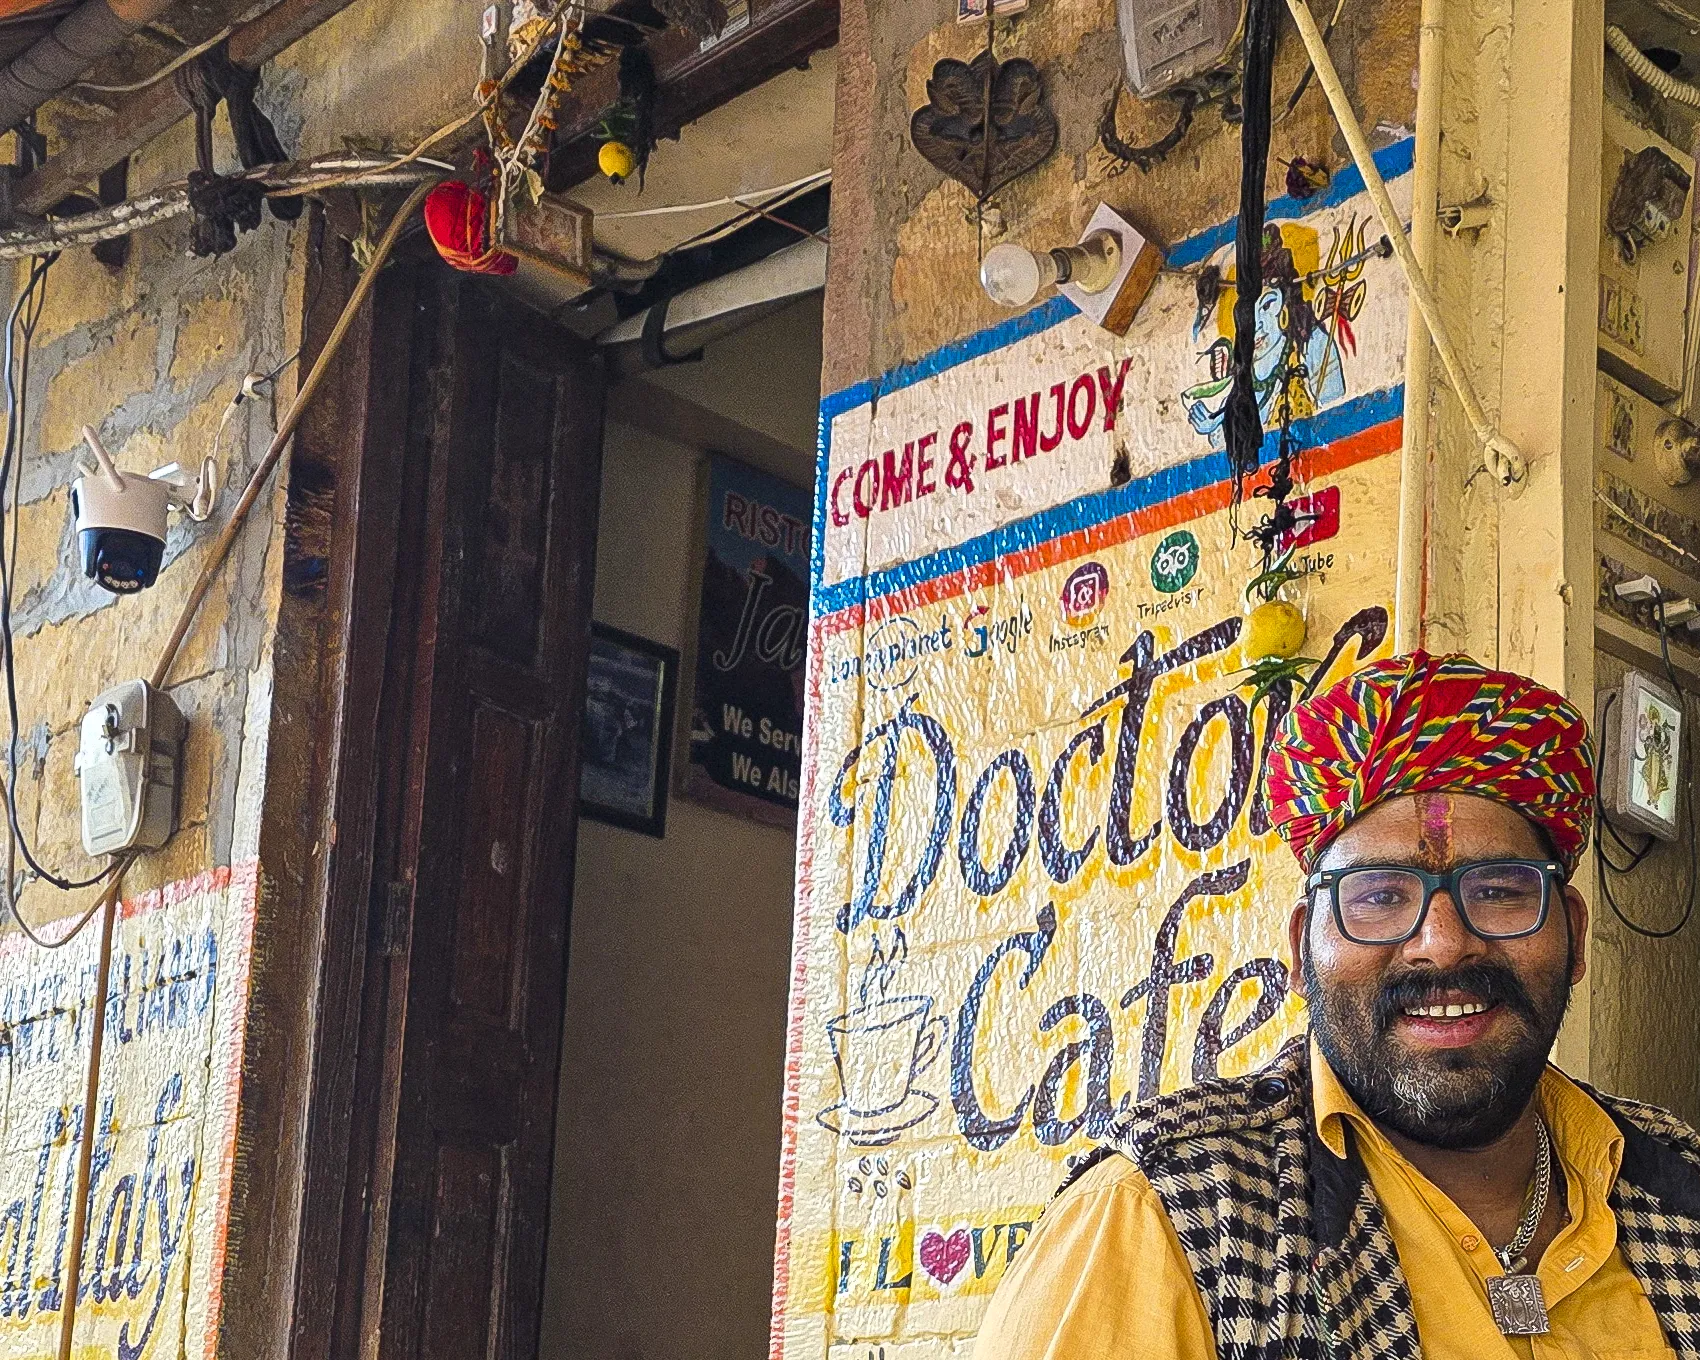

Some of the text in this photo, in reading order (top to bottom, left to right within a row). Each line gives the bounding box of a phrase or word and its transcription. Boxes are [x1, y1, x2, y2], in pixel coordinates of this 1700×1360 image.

[831, 357, 1133, 528] COME & ENJOY
[724, 490, 808, 555] RIST
[1050, 624, 1109, 652] Instagram
[1137, 587, 1204, 619] Tripadvisr
[723, 702, 752, 739] We
[732, 751, 761, 786] We
[950, 858, 1290, 1152] Cafe
